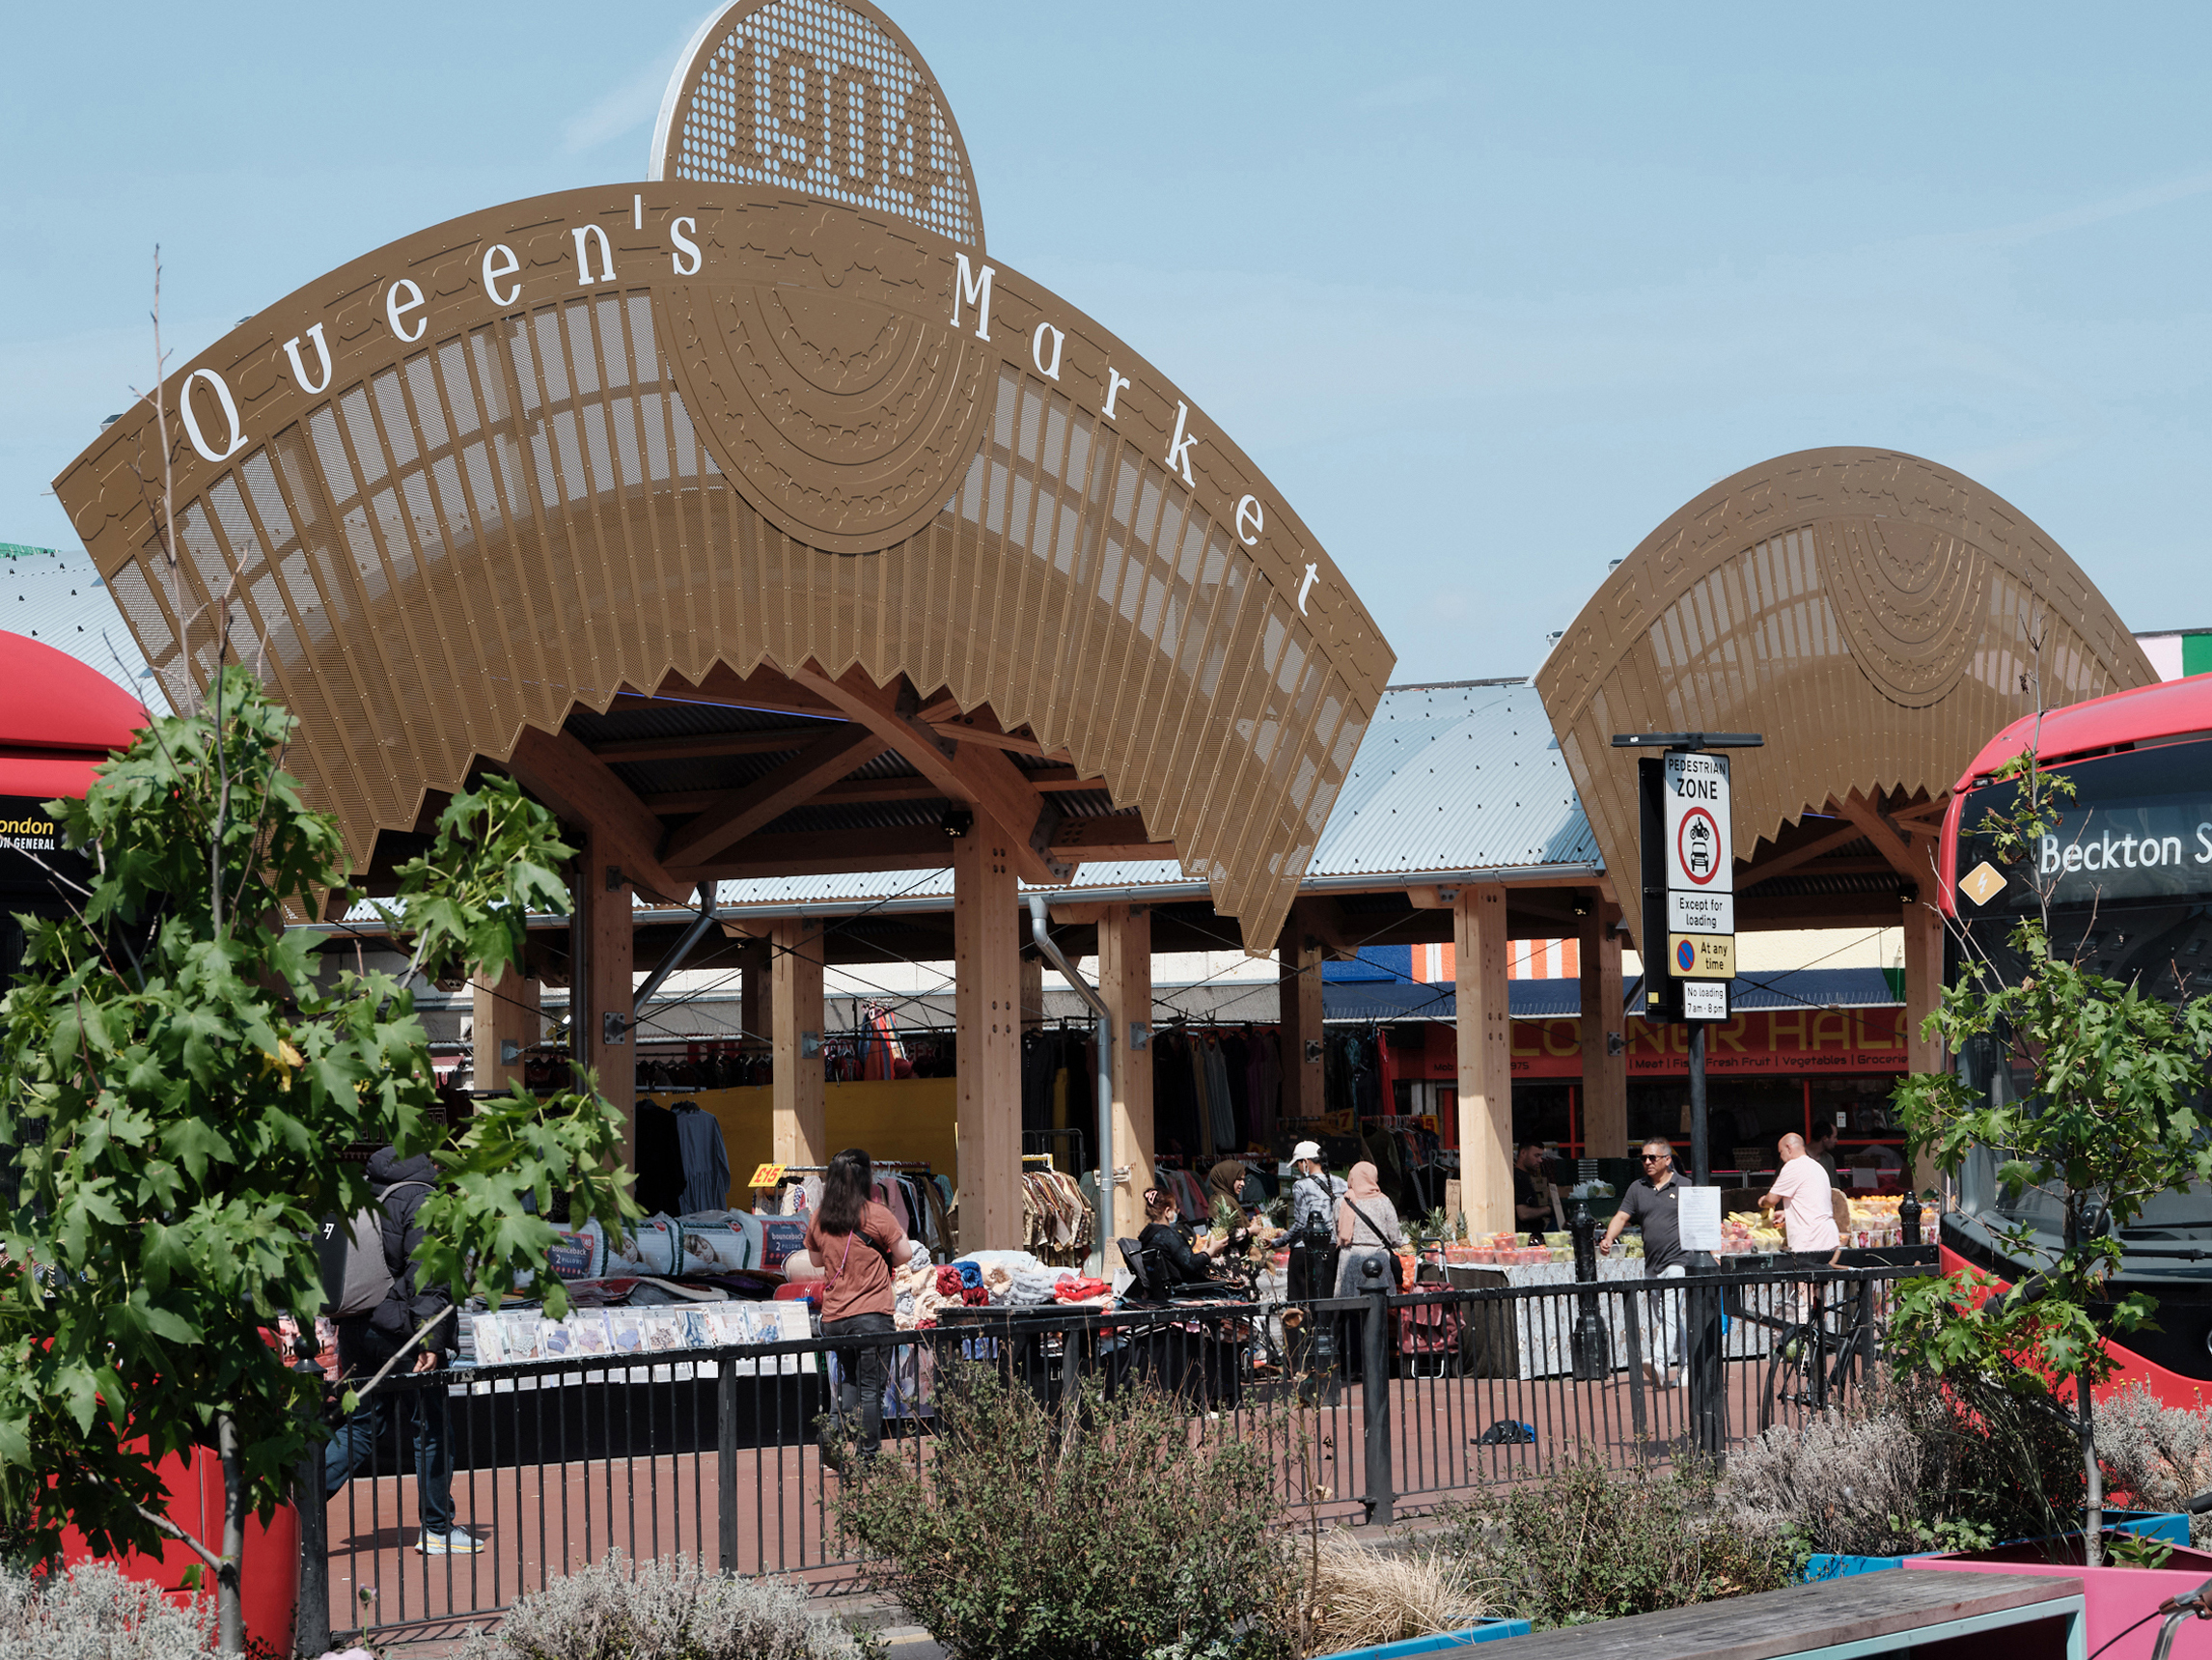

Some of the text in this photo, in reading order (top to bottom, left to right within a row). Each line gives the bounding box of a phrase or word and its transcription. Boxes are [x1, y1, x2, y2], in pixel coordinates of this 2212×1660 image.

[179, 194, 1320, 617] Queen's Market
[1669, 759, 1726, 775] PEDESTRIAN
[1677, 778, 1718, 799] ZONE
[14, 837, 55, 850] GENERAL
[2040, 829, 2182, 873] Beckton
[1679, 898, 1723, 912] Except for
[1686, 914, 1717, 928] loading
[1700, 942, 1728, 956] At any
[1705, 958, 1724, 970] time
[1687, 987, 1724, 999] No loading
[1509, 1015, 1747, 1056] CONER
[1635, 1053, 1908, 1068] Meat Fis Fresh Fruit Vegetables Grocerie
[754, 1167, 781, 1183] £15
[551, 1245, 587, 1256] bounceback
[775, 1241, 781, 1251] 2
[556, 1255, 583, 1265] 2 PILLOWS
